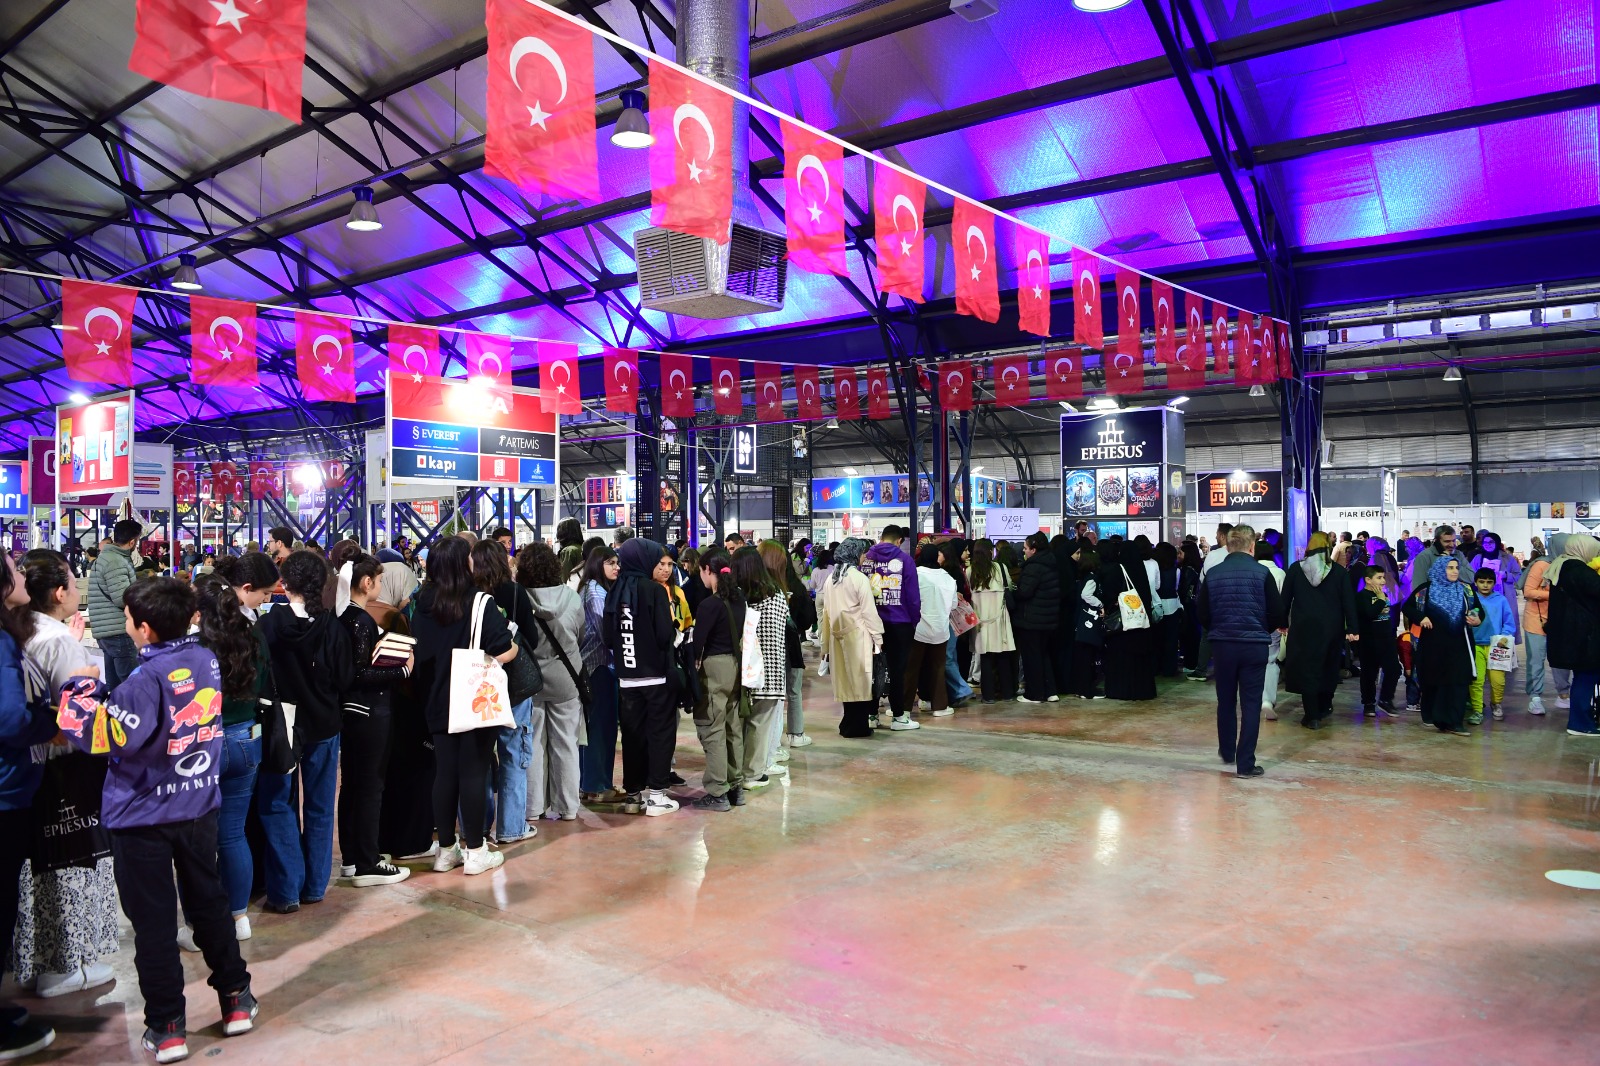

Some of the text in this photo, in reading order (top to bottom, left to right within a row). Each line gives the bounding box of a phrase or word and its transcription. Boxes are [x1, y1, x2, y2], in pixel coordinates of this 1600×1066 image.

[422, 428, 460, 441] EVEREST
[505, 436, 540, 450] ARTEMİS
[1081, 444, 1143, 460] EPHESUS
[428, 455, 456, 474] kapı
[621, 633, 636, 668] PRO
[172, 678, 195, 689] GEOX
[175, 684, 194, 694] TOTAL
[44, 814, 99, 838] EPHESUS
